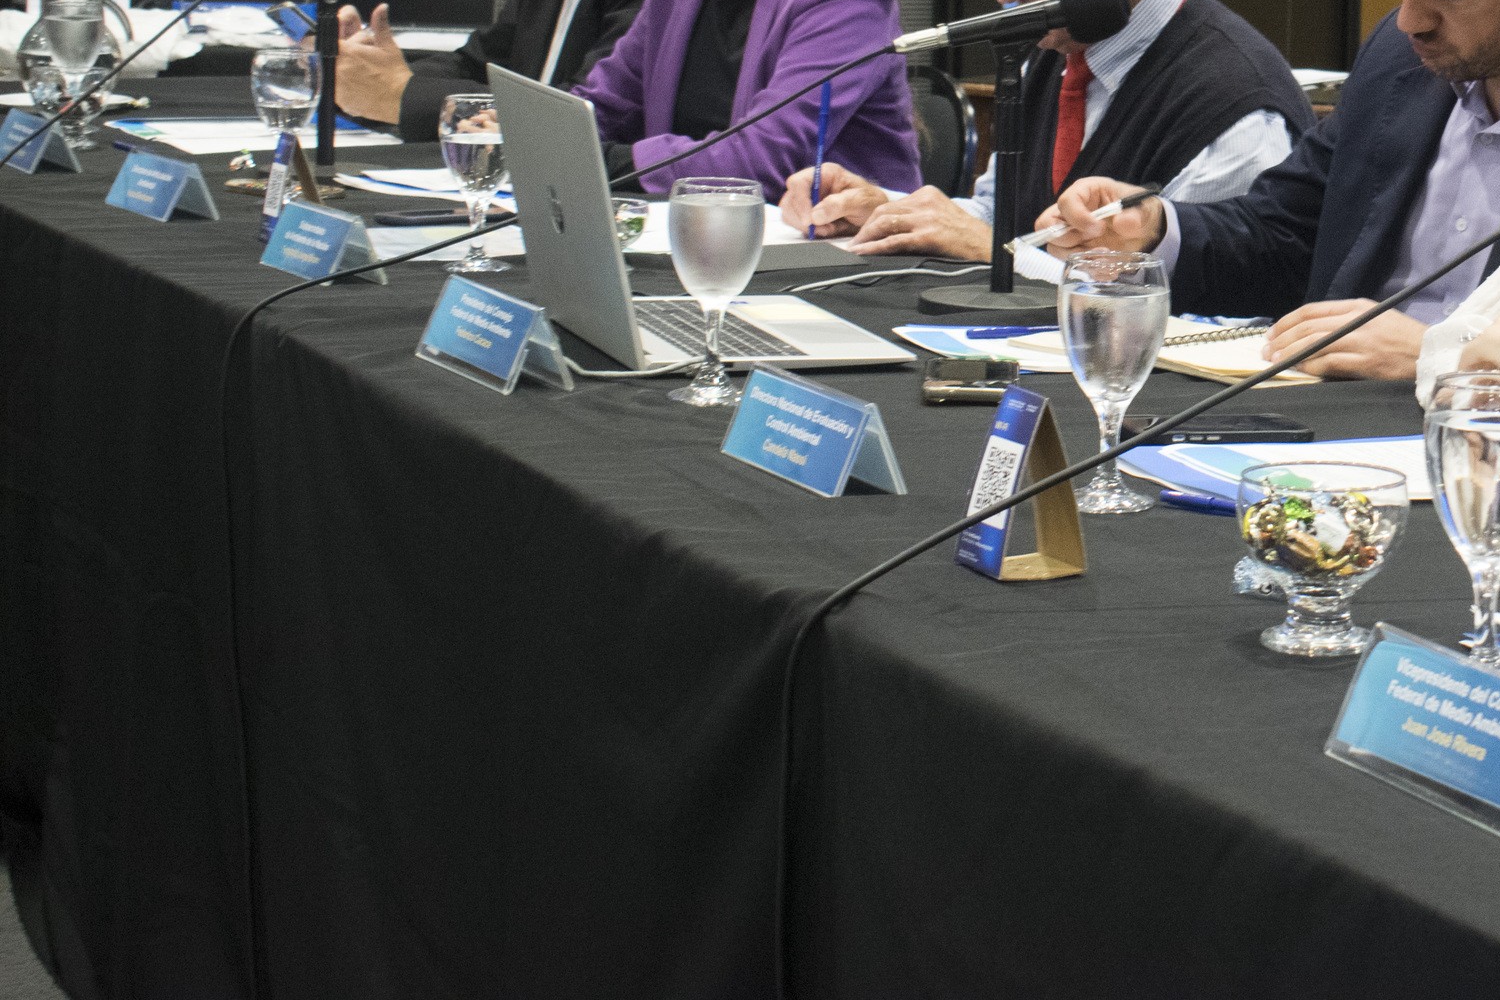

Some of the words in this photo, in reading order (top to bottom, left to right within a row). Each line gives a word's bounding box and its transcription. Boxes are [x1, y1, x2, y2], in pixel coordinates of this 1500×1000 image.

[1387, 679, 1428, 707] Federal
[1424, 694, 1440, 713] de
[1438, 700, 1473, 725] Medio
[1397, 656, 1471, 698] Vicepresidente
[1468, 685, 1491, 704] del
[1402, 716, 1428, 737] Juan
[1426, 724, 1454, 748] José
